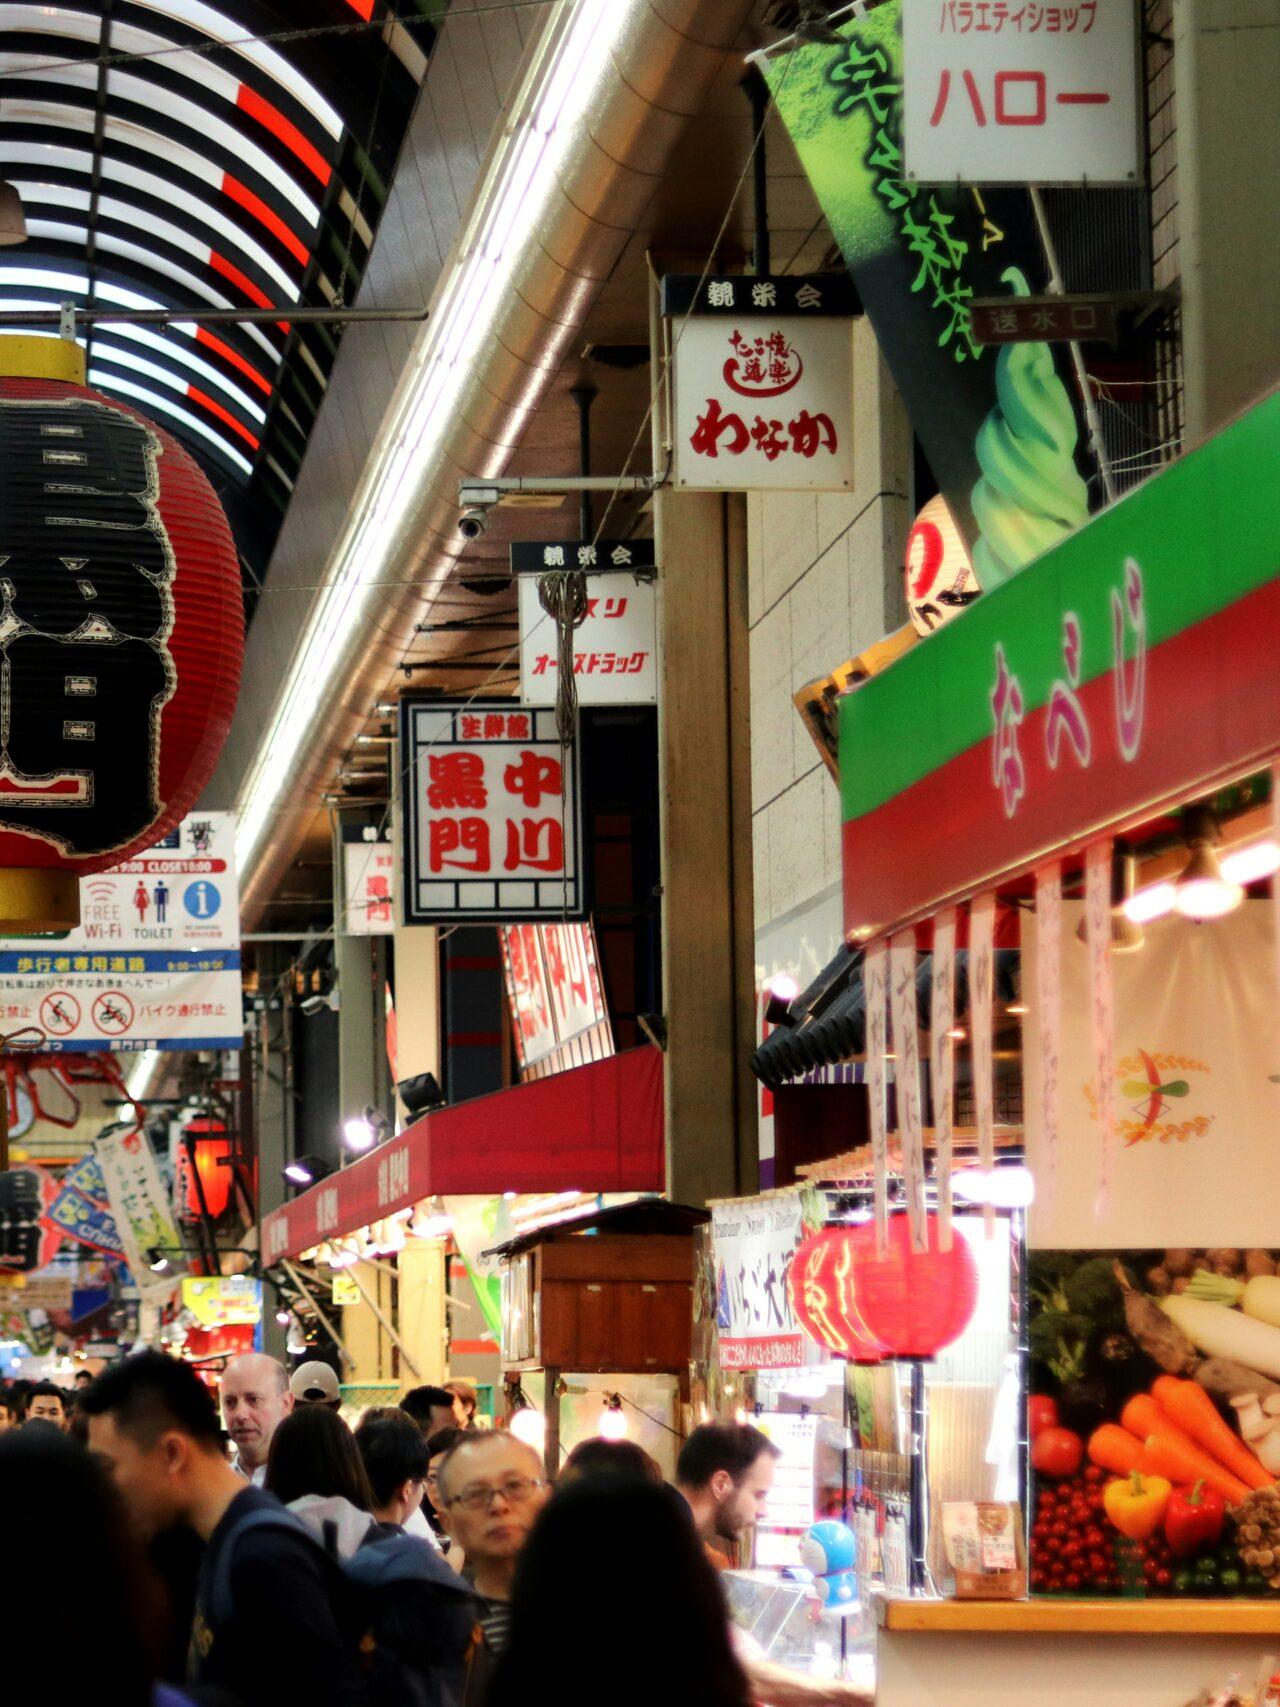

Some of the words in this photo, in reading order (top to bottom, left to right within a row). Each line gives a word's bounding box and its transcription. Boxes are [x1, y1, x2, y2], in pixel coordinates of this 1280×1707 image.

[929, 68, 1111, 127] ハロー
[708, 281, 822, 308] 親栄会
[990, 308, 1097, 334] 送水口
[690, 398, 838, 461] わなか
[544, 545, 632, 566] 親栄会
[532, 652, 649, 676] オースドラッグ
[426, 751, 492, 874] 黒門
[84, 904, 120, 921] FREE
[84, 924, 122, 939] Wi-Fi
[134, 928, 173, 939] TOILET
